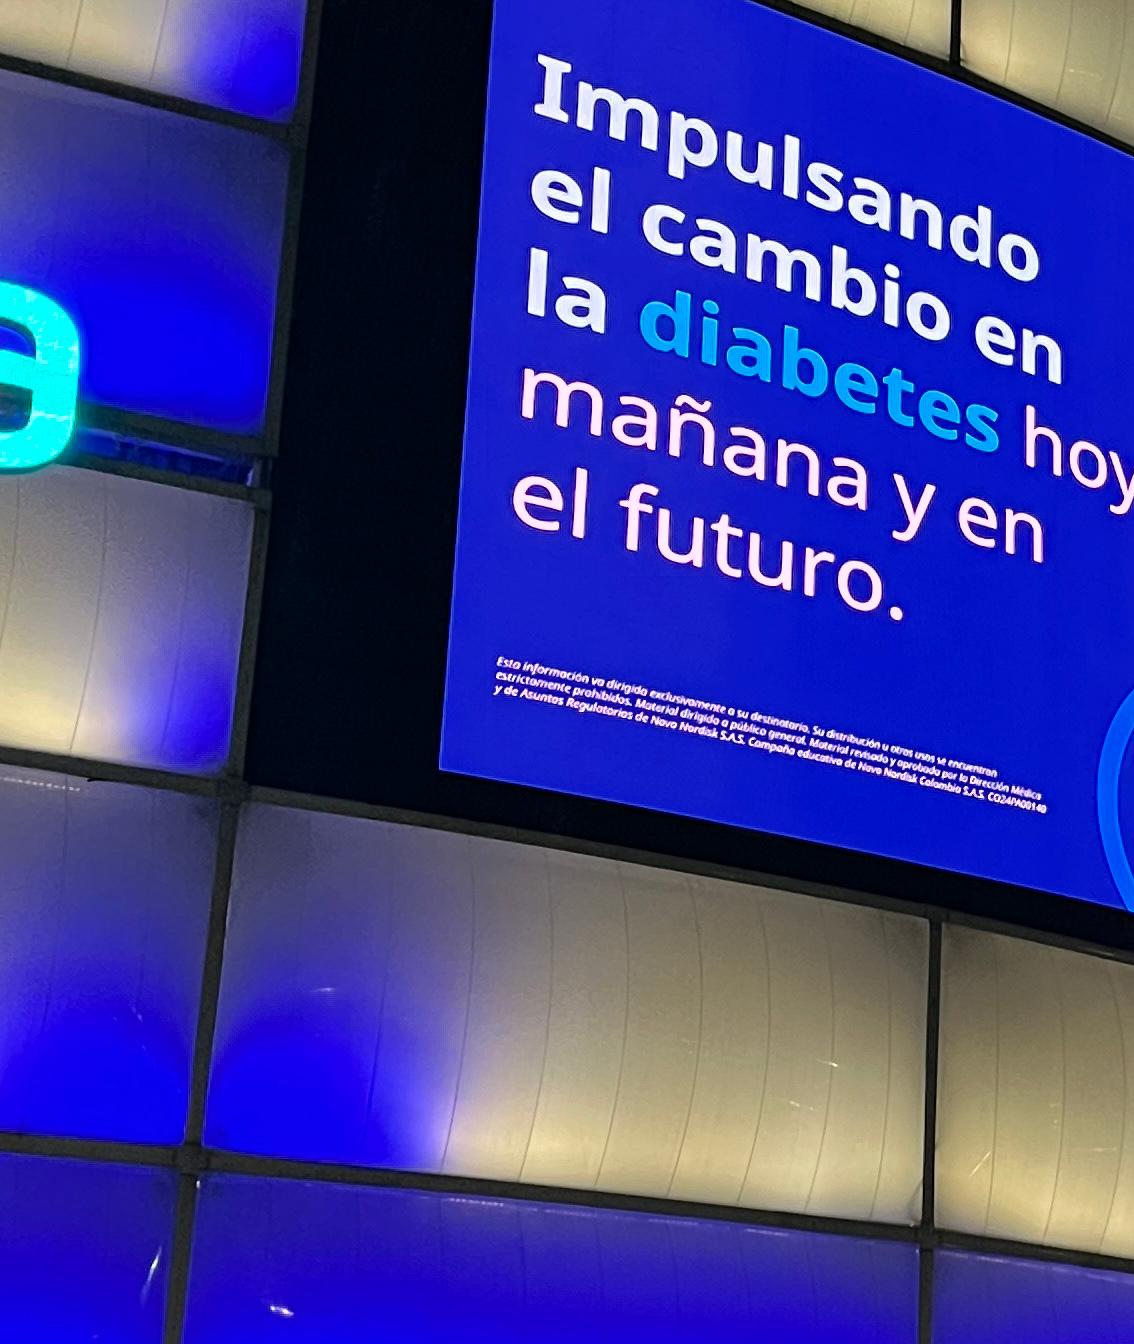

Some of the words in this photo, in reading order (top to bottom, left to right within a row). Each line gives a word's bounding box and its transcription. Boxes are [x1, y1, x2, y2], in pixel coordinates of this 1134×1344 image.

[531, 54, 1039, 281] Impulsando
[528, 248, 606, 334] la
[640, 290, 999, 452] diabetes
[531, 167, 610, 233] el
[643, 205, 950, 340] cambio
[975, 316, 1061, 384] en
[513, 467, 587, 538] el
[619, 483, 903, 620] futuro.
[522, 368, 867, 510] mañana
[892, 474, 936, 541] y
[959, 498, 1043, 563] en
[496, 672, 570, 694] estrictamente
[573, 688, 632, 707] prohibidos.
[635, 698, 678, 717] Material
[680, 707, 719, 725] dirigido
[730, 719, 766, 736] público
[769, 729, 806, 745] general.
[810, 736, 848, 754] Material
[497, 656, 521, 670] Esta
[522, 661, 589, 684] información
[592, 678, 605, 688] va
[607, 678, 647, 696] dirigida
[650, 690, 726, 714] exclusivamente
[737, 709, 749, 719] su
[751, 710, 810, 733] destinatario.
[812, 724, 824, 736] Su
[826, 727, 881, 749] distribución
[504, 686, 518, 697] de
[520, 689, 564, 706] Asuntos
[566, 699, 633, 721] Regulatorios
[635, 713, 648, 724] de
[650, 716, 677, 730] Novo
[679, 722, 718, 739] Nordisk
[720, 731, 745, 745] S.A.S.
[748, 737, 795, 756] Campaña
[797, 749, 842, 766] educativa
[845, 758, 856, 769] de
[858, 761, 881, 775] Novo
[884, 767, 917, 783] Nordisk
[919, 775, 961, 794] Colombia
[963, 785, 984, 799] S.A.S.
